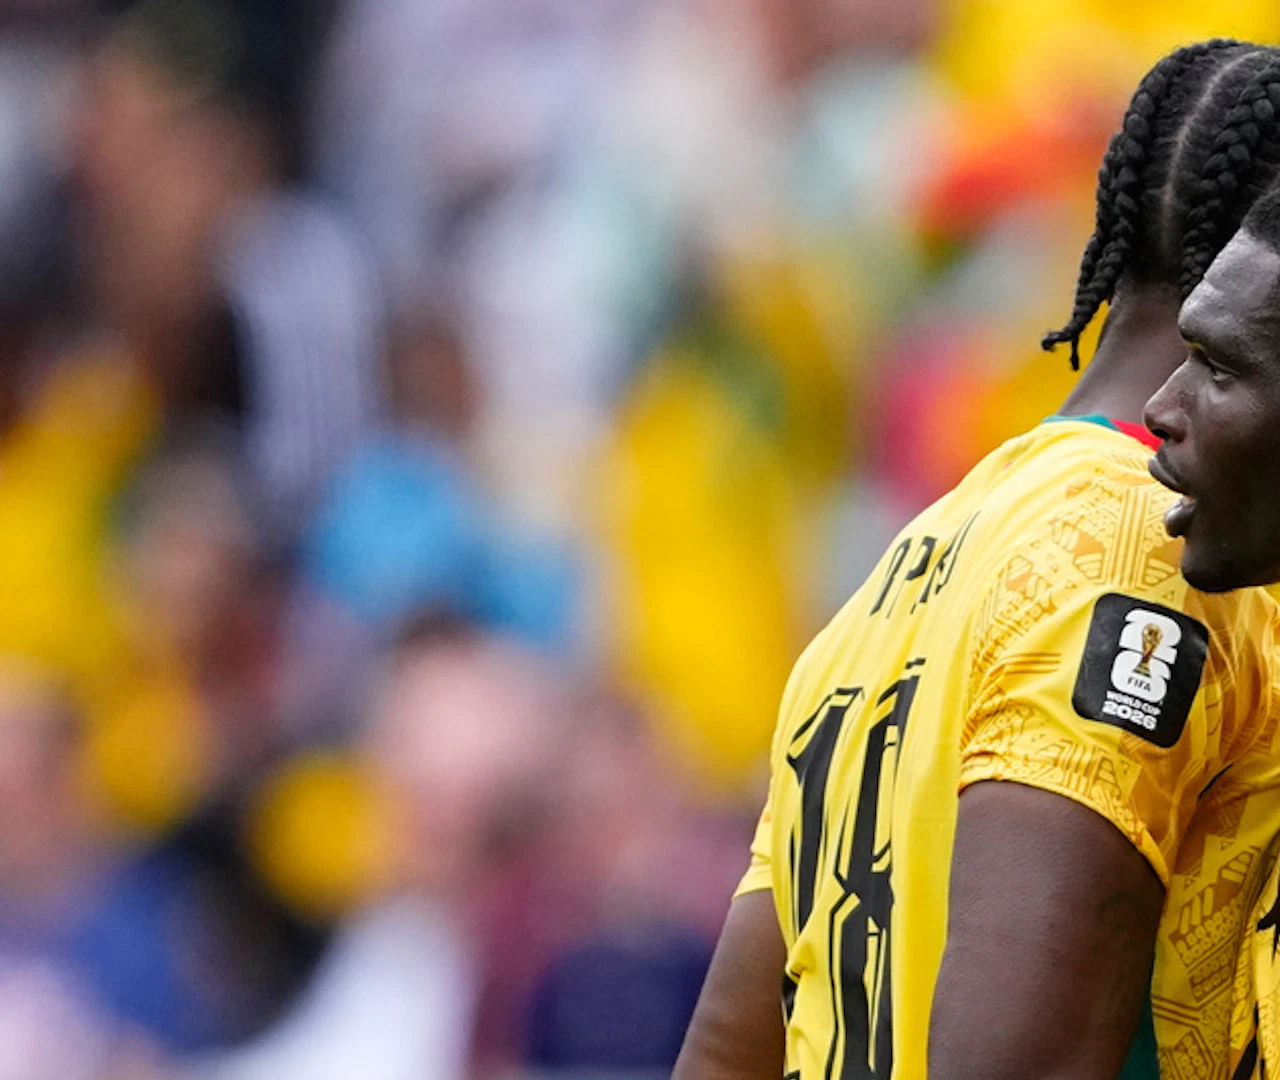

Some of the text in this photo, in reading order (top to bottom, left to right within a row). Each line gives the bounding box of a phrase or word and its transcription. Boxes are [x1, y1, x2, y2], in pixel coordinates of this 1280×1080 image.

[1127, 677, 1151, 692] FIFA
[1102, 700, 1158, 730] 2026
[1106, 690, 1161, 716] WORLD CUP
